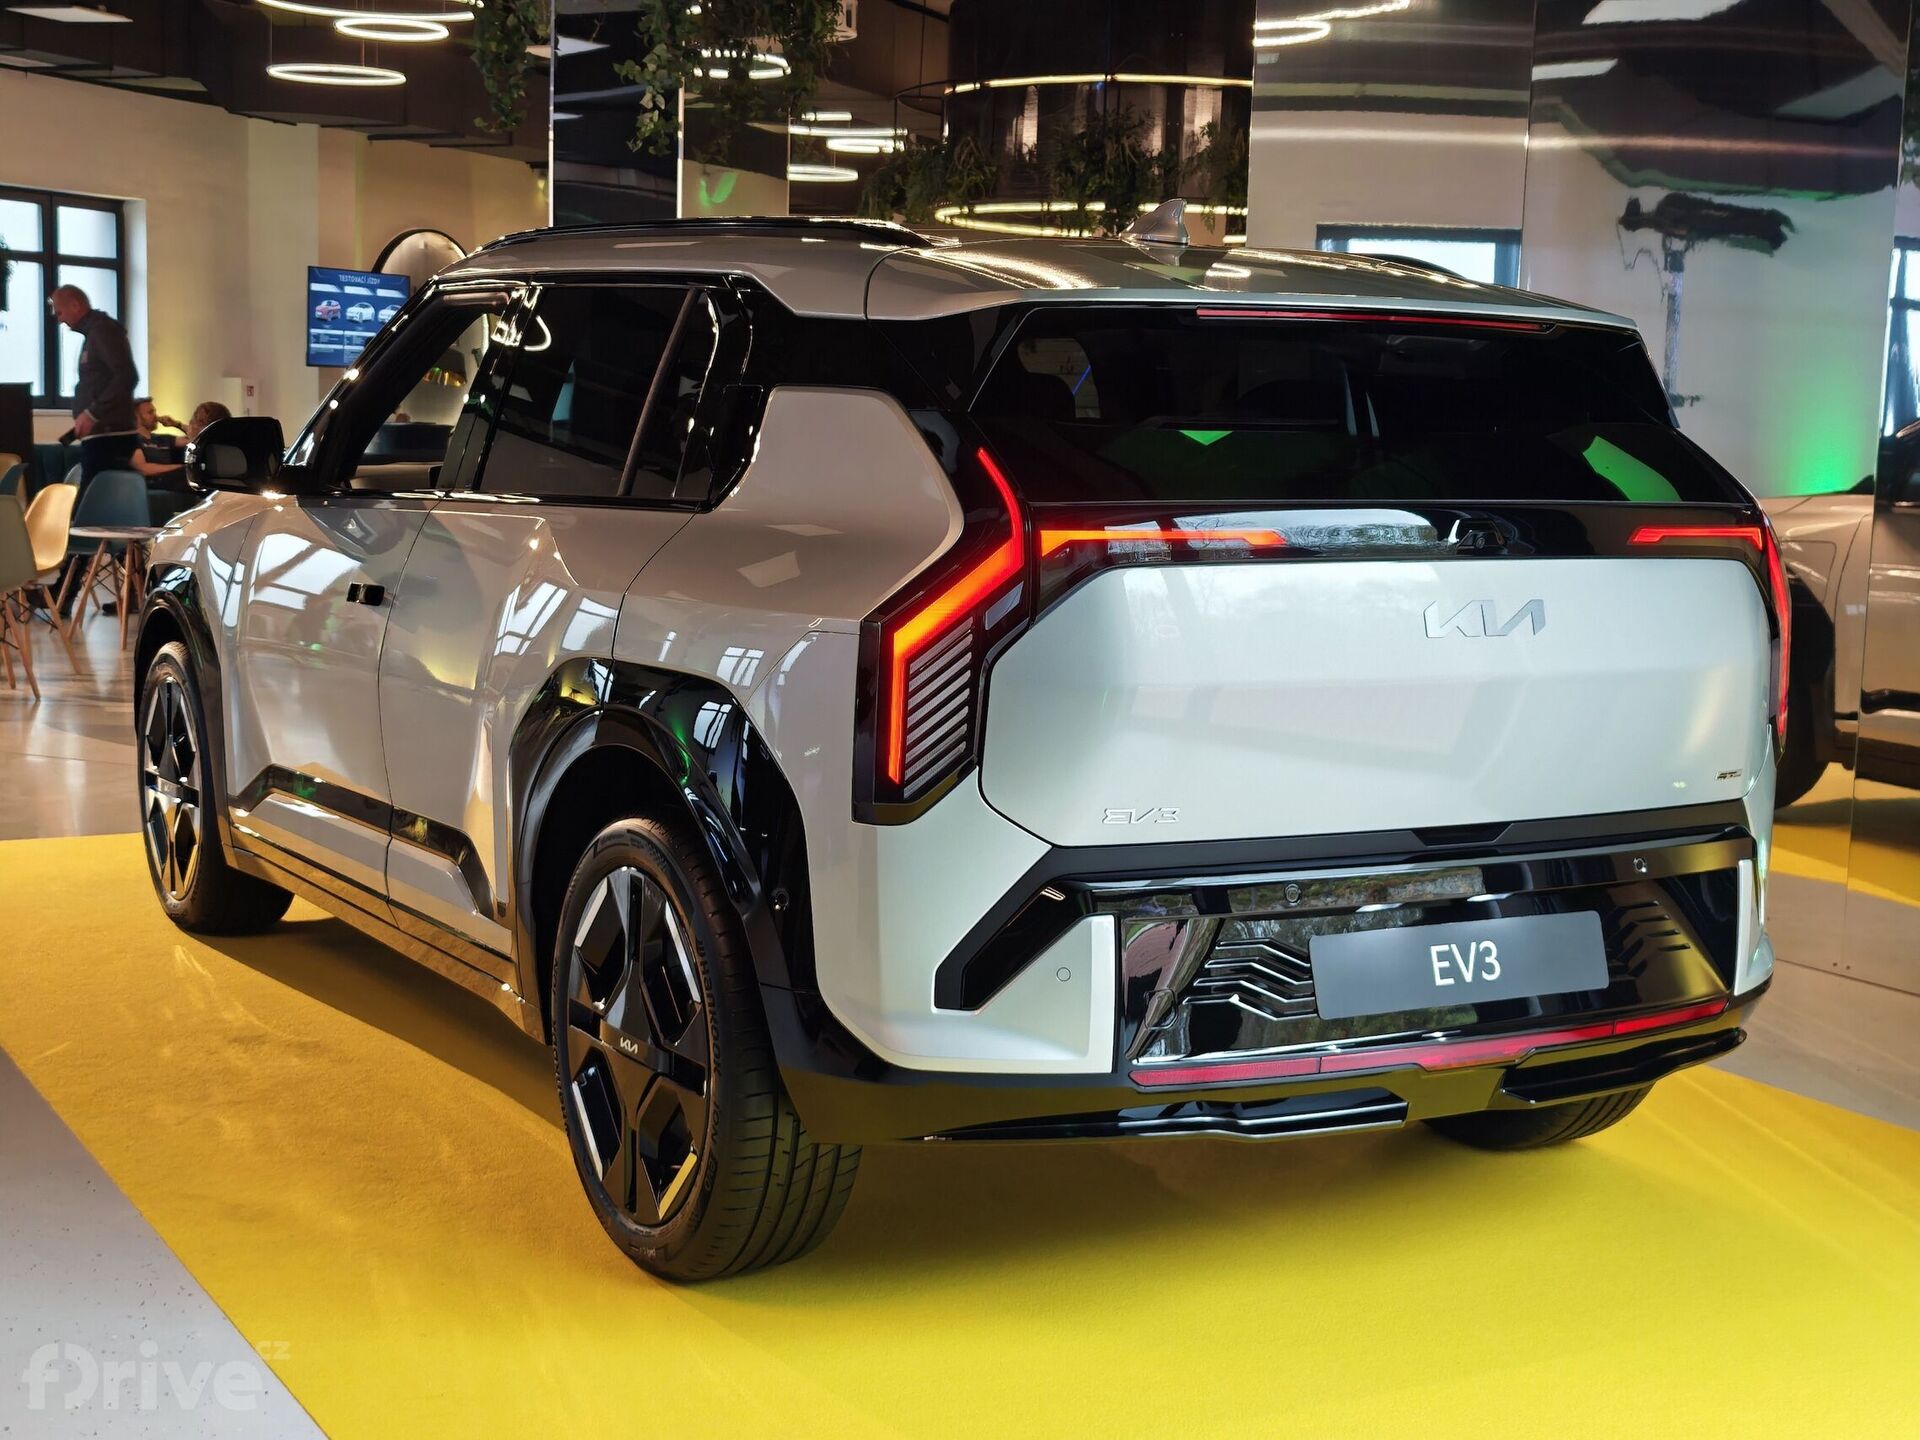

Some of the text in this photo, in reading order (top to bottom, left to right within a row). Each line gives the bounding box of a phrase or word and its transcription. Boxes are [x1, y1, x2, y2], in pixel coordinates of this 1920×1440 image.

[1423, 598, 1546, 639] KIA
[1102, 808, 1180, 824] EV3
[1430, 940, 1501, 987] EV3
